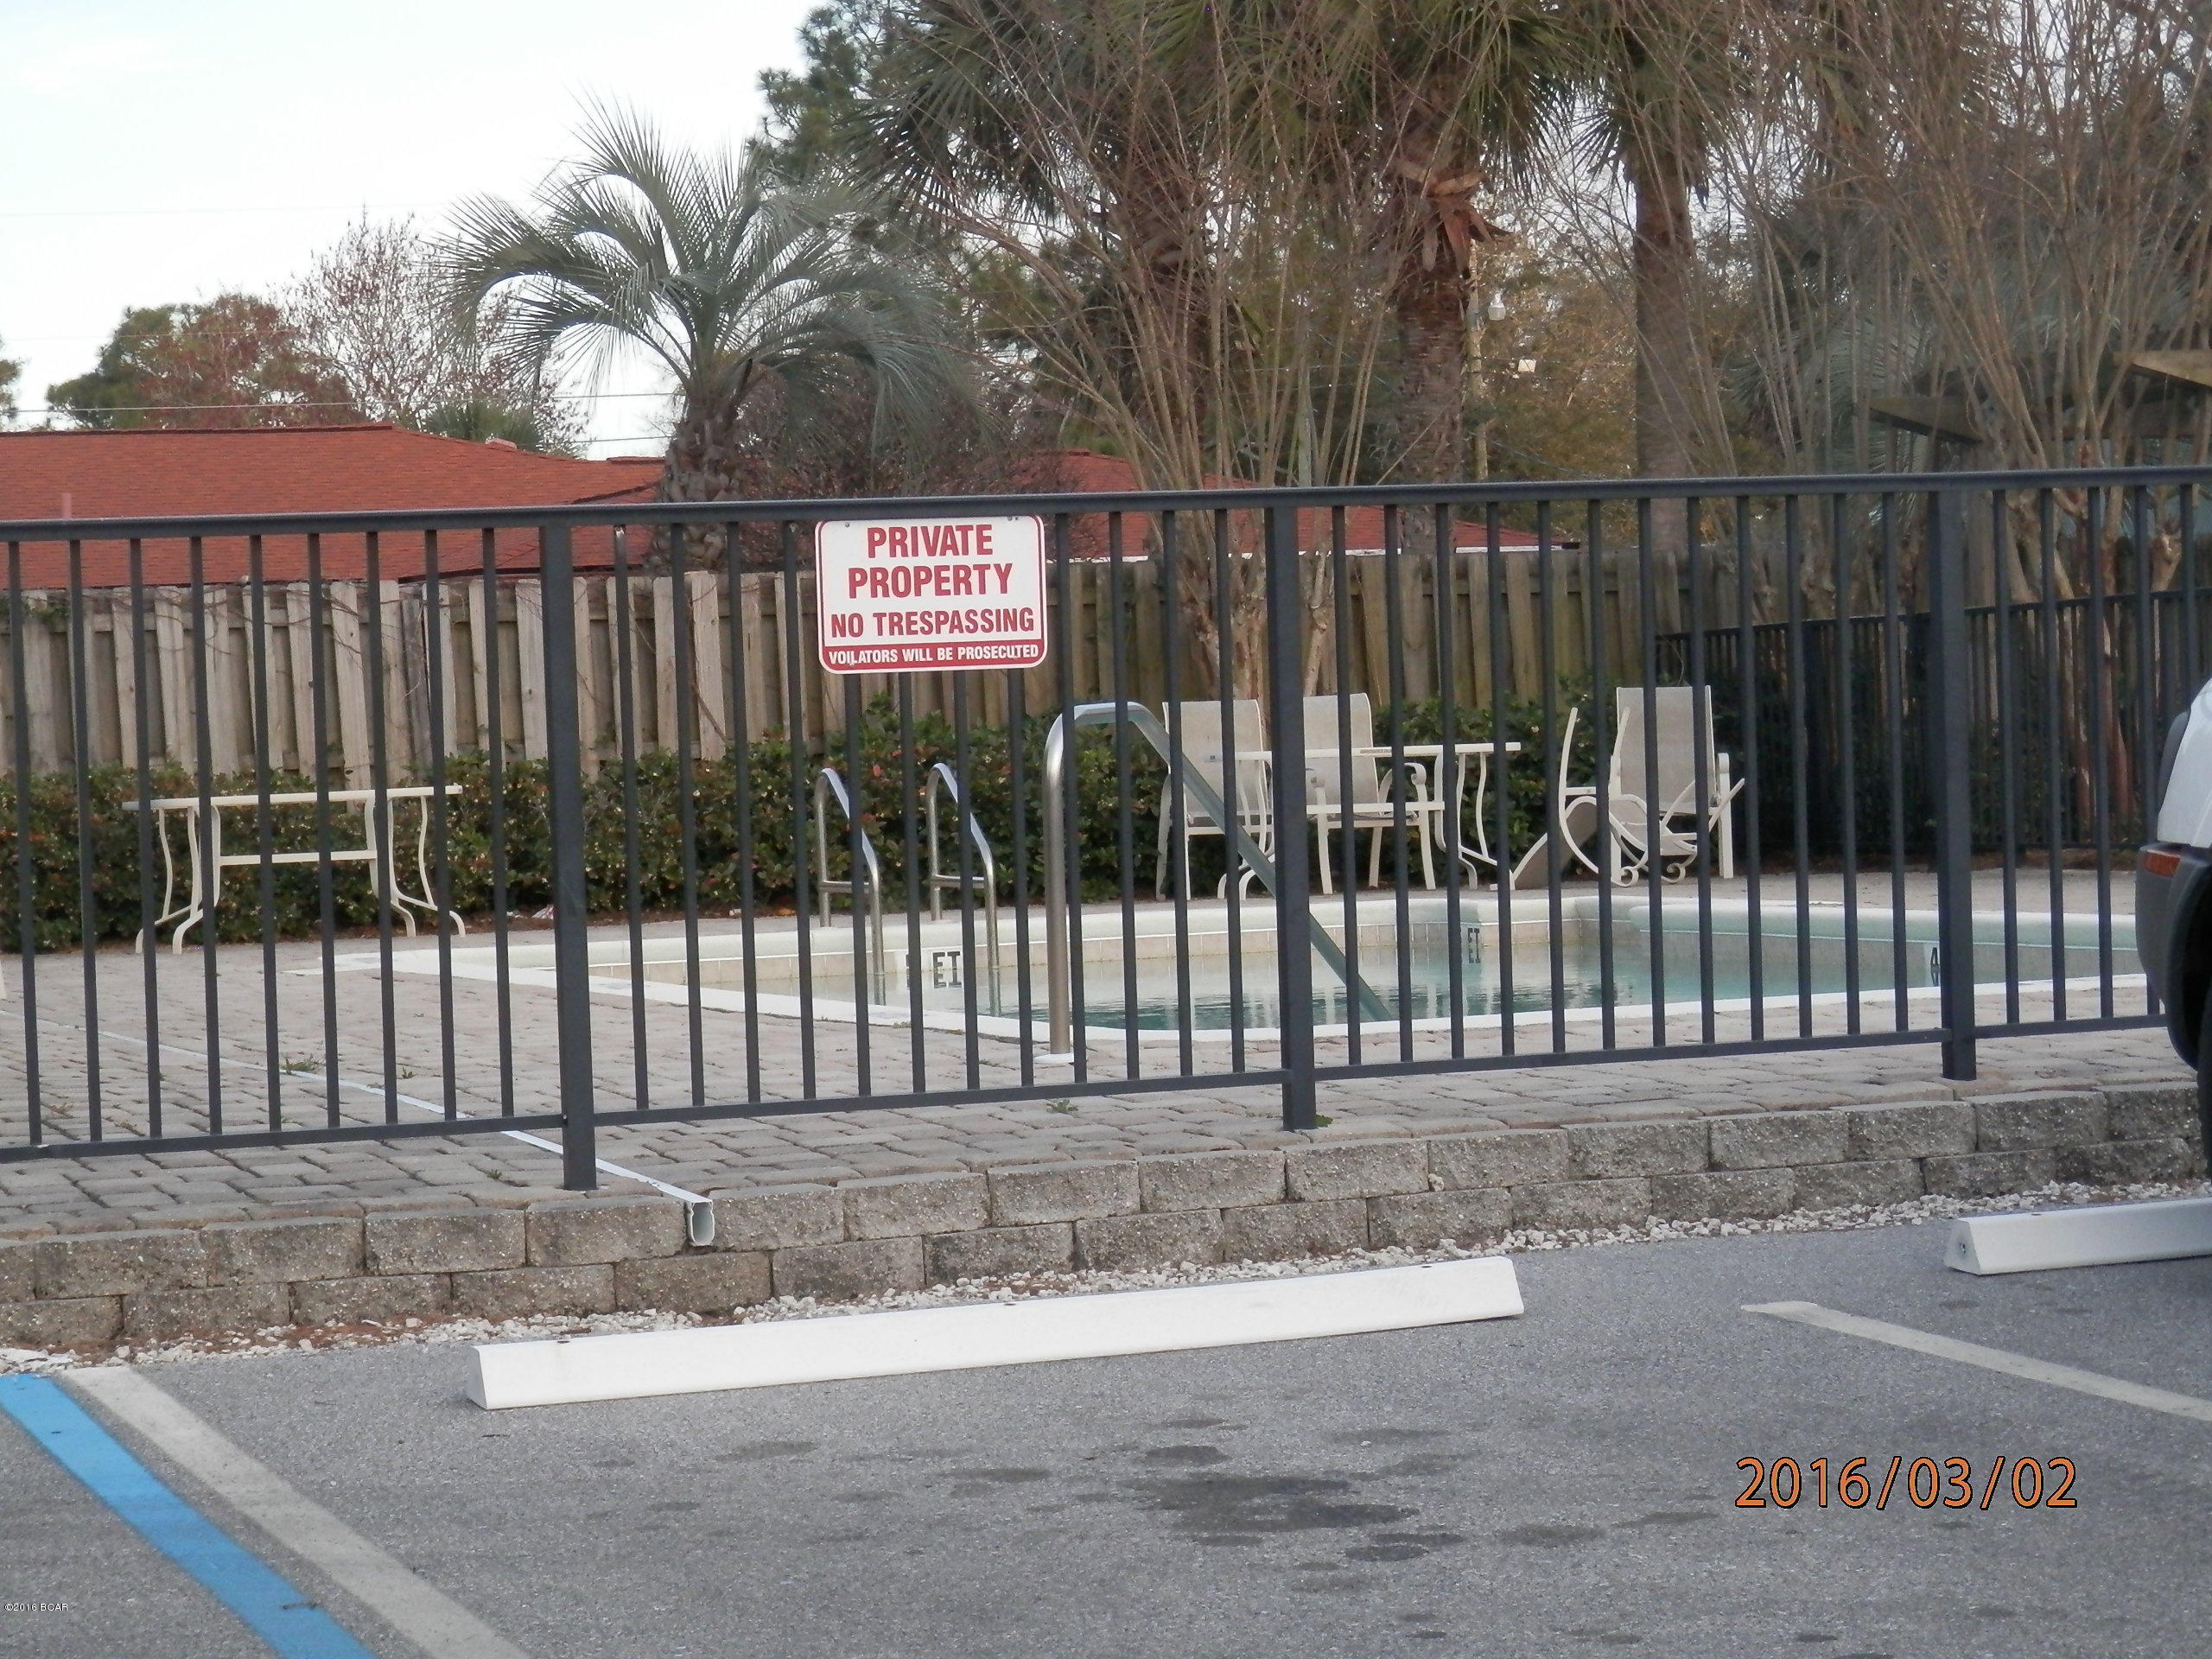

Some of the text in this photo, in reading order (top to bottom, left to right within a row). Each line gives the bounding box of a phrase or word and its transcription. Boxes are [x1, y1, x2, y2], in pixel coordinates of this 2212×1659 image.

[868, 524, 993, 558] PRIVATE
[849, 563, 1013, 599] PROPERTY
[831, 607, 1033, 638] NO TRESPASSING
[830, 645, 1039, 664] VOILATORS WILL BE PROSECUTED
